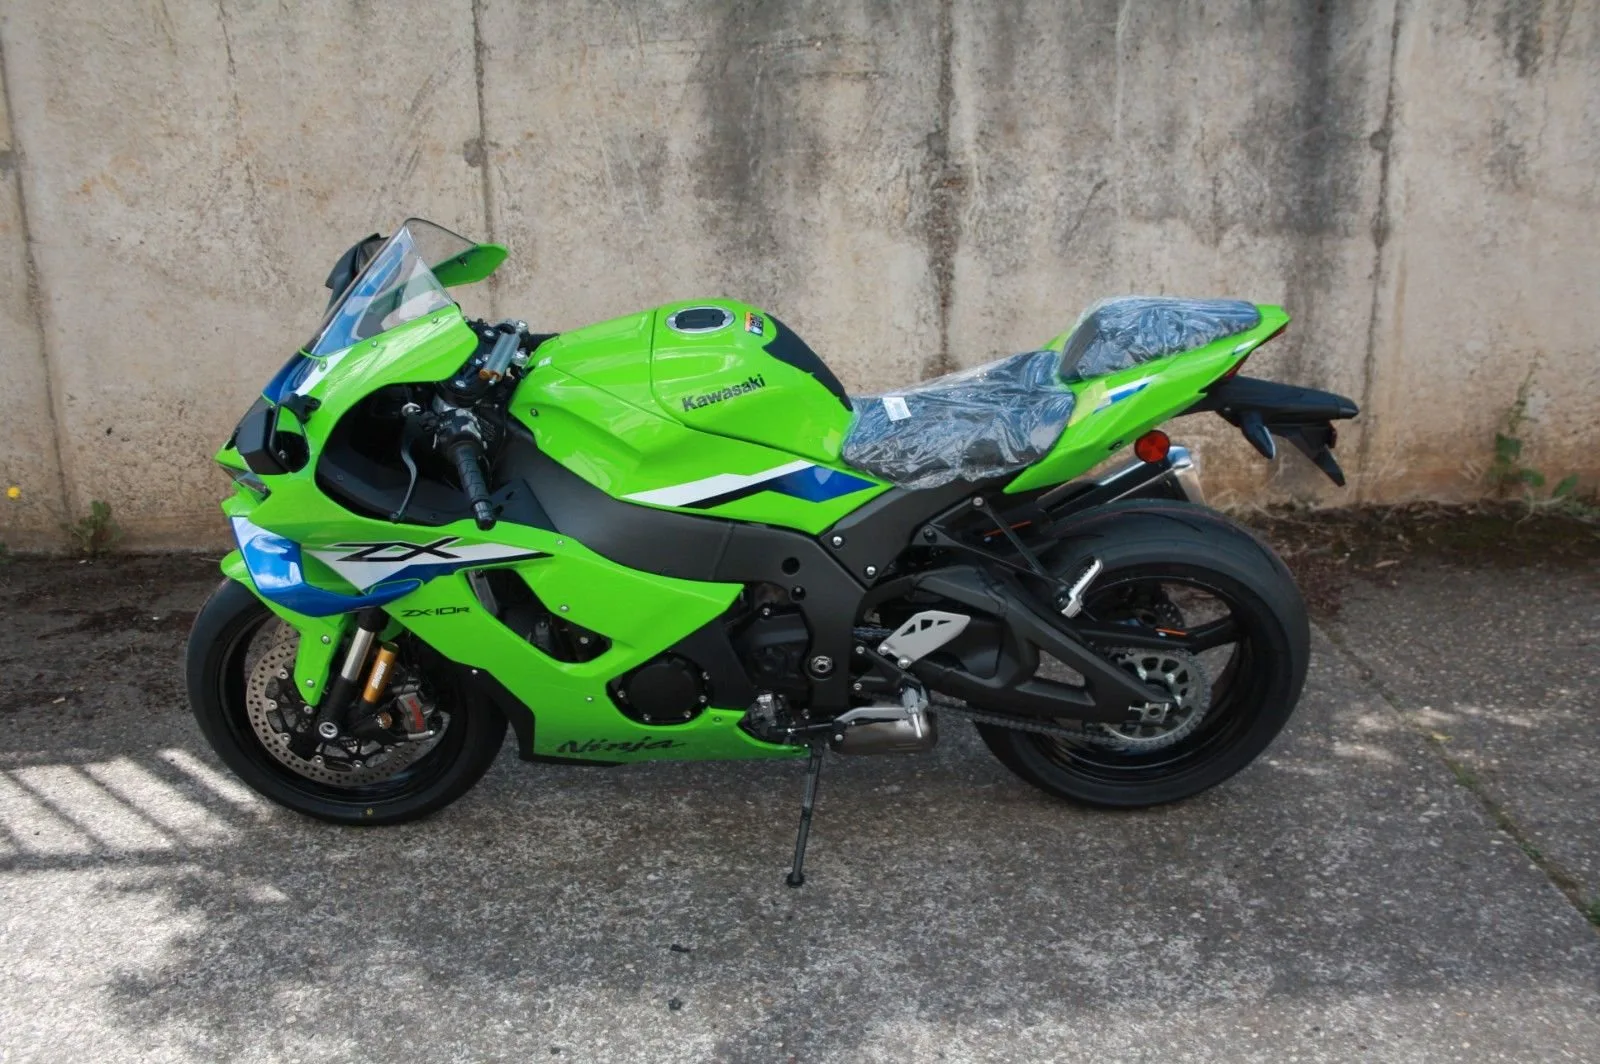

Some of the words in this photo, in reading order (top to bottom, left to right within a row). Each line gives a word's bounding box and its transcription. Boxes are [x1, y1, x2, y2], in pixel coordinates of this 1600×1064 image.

[682, 373, 765, 412] Kawasaki
[334, 536, 462, 561] ZX
[401, 606, 471, 617] ZX-10R
[556, 736, 687, 753] Ninja
